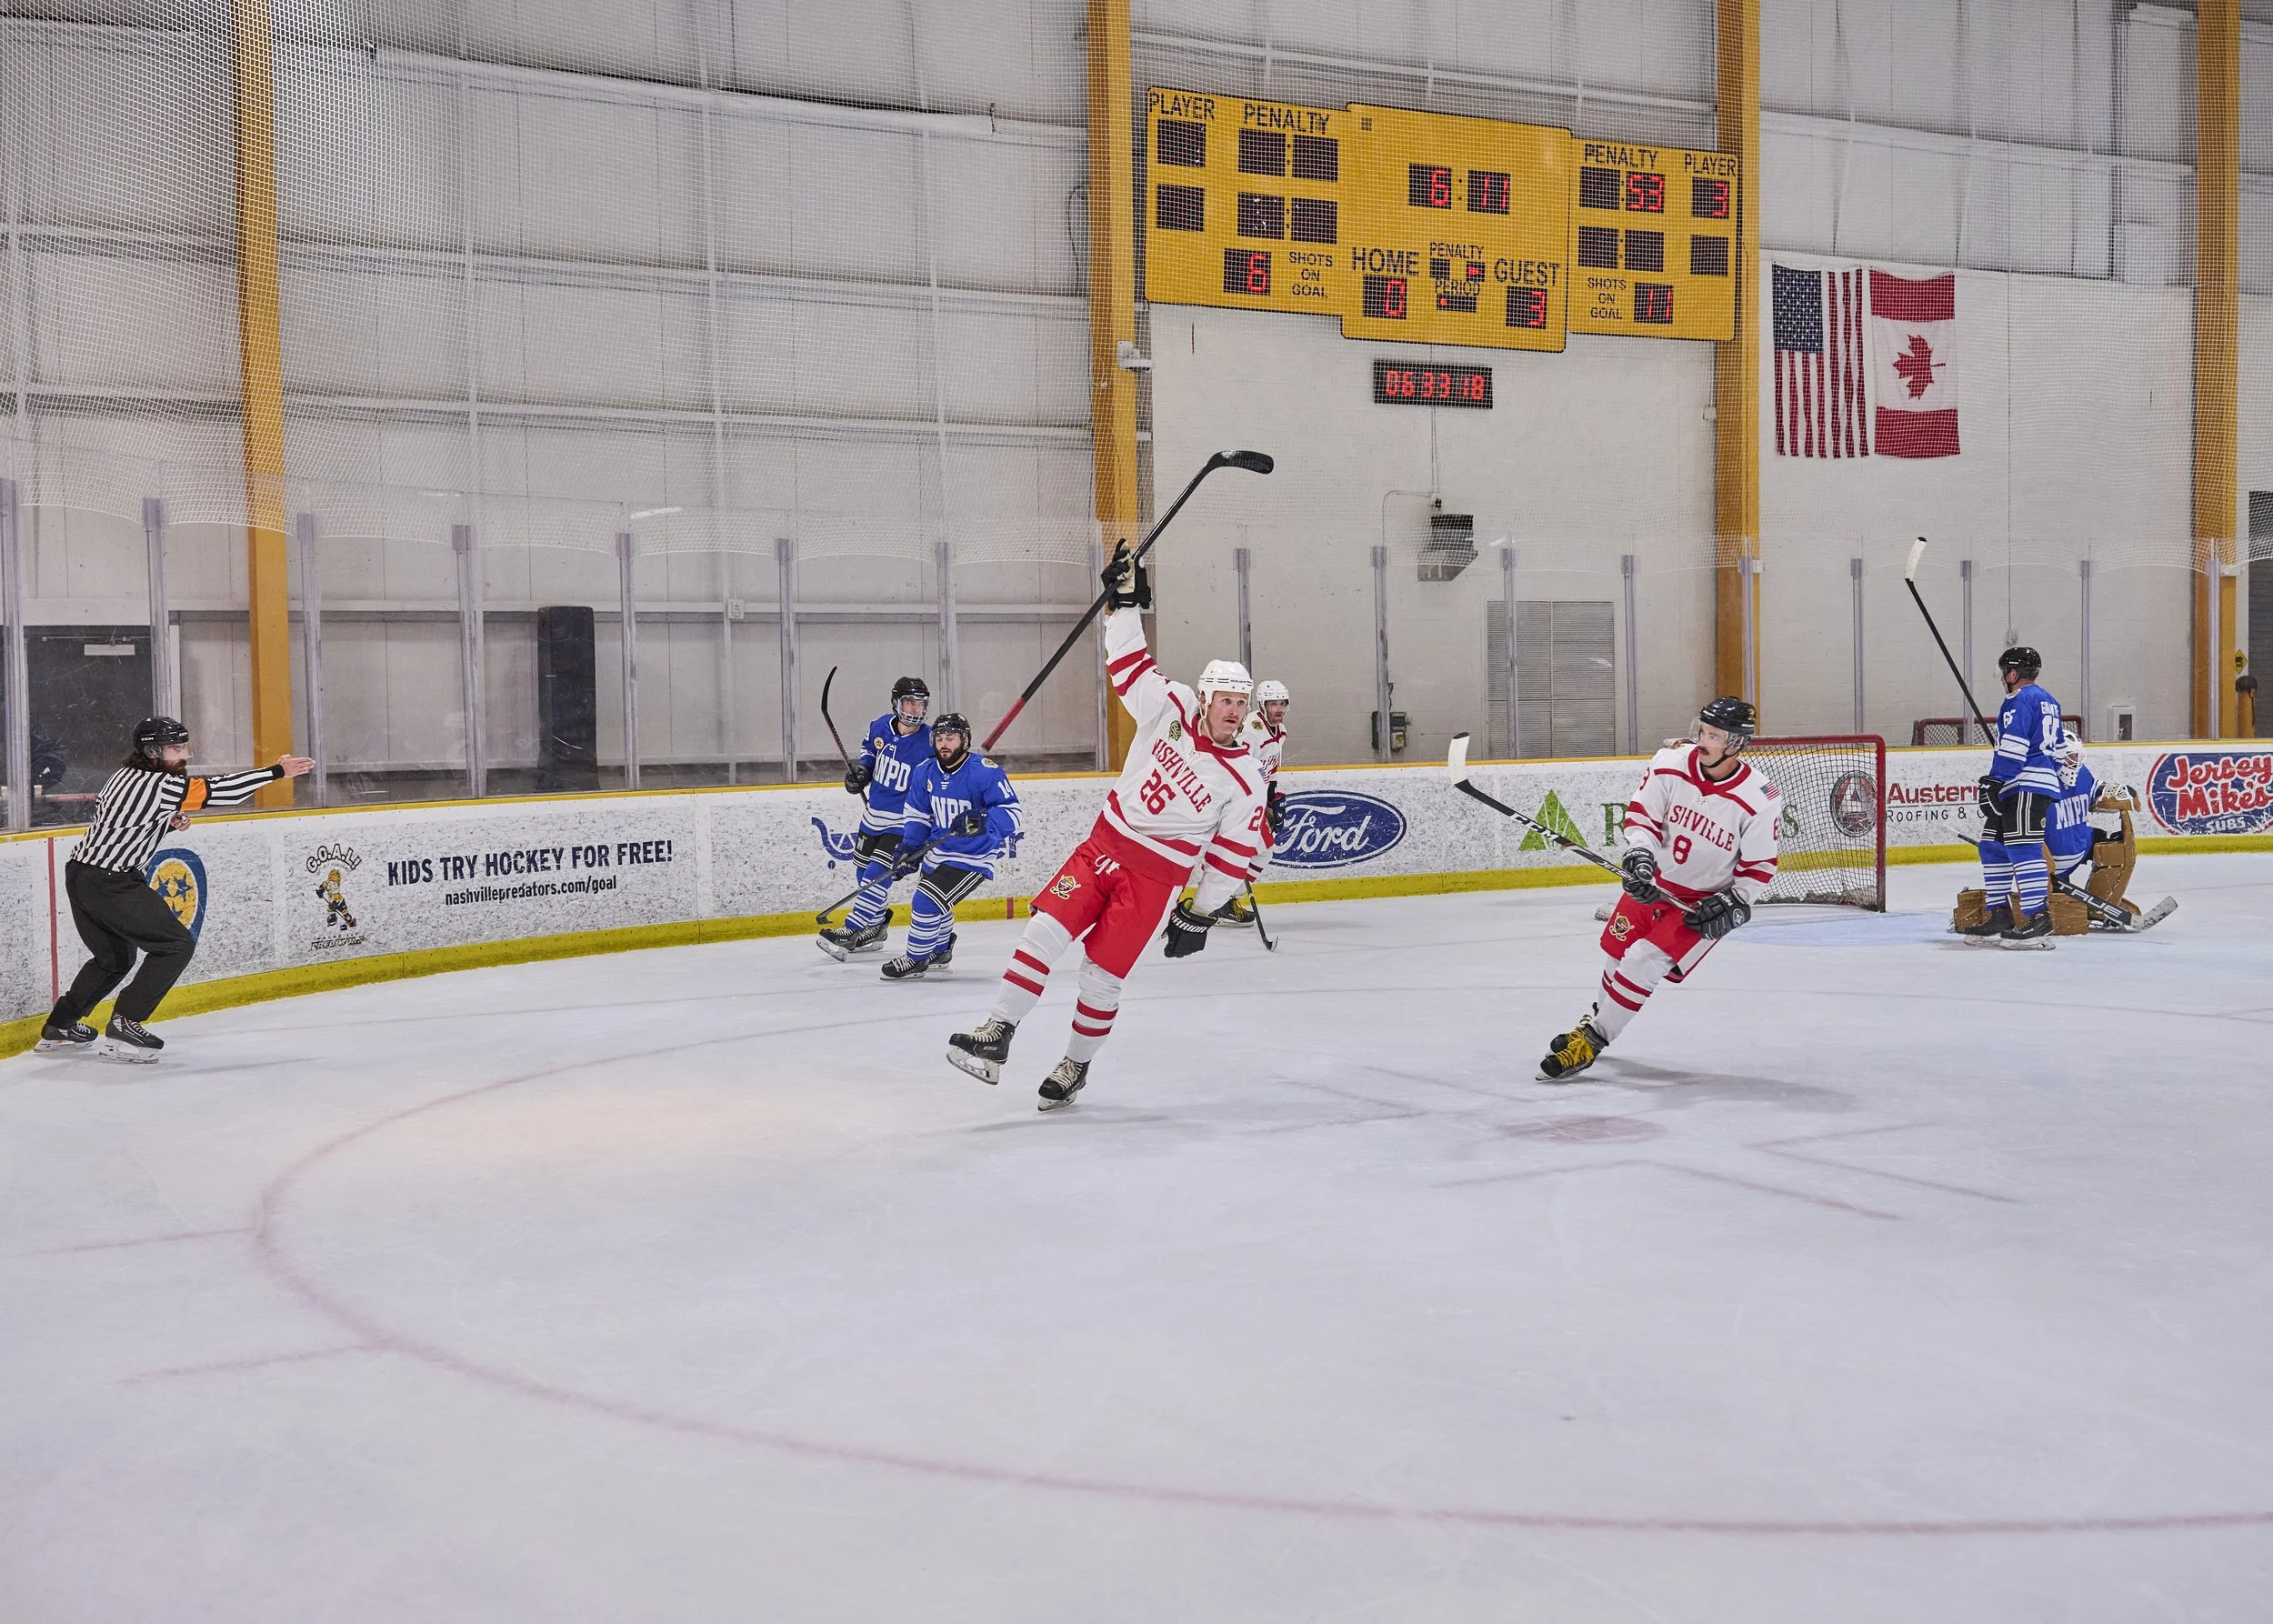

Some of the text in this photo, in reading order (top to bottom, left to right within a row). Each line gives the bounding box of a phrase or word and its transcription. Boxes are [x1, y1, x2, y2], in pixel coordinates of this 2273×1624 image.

[1148, 92, 1215, 120] PLAYER
[1243, 104, 1330, 135] PENALTY
[1585, 143, 1658, 169] PENALTY
[1684, 153, 1737, 176] PLAYER
[1713, 182, 1727, 216] 3
[1288, 250, 1333, 267] SHOTS
[1351, 246, 1419, 276] HOME
[1429, 241, 1485, 259] PENALTY
[1247, 253, 1267, 293] 6
[1301, 269, 1321, 282] ON
[1494, 258, 1560, 286] GUEST
[1587, 276, 1627, 290] SHOTS
[1291, 283, 1328, 298] GOAL
[1385, 279, 1406, 316] 0
[1435, 278, 1480, 297] PERIOD
[1597, 292, 1616, 305] ON
[1528, 290, 1546, 326] 3
[1590, 307, 1623, 320] GOAL
[2168, 755, 2273, 789] Jersey
[997, 778, 1016, 799] 14
[1139, 767, 1177, 816] 26
[2178, 781, 2273, 820] Mike's
[1273, 804, 1372, 854] Ford
[1886, 807, 1948, 823] ROOFING
[1958, 807, 1968, 819] &
[2207, 817, 2246, 832] SUBS
[387, 858, 434, 886] KIDS
[439, 854, 478, 881] TRY
[485, 847, 565, 877] HOCKEY
[571, 844, 611, 869] FOR
[616, 839, 673, 866] FREE!
[1672, 834, 1693, 865] 8
[445, 875, 617, 906] nashvillepredators.com/goal
